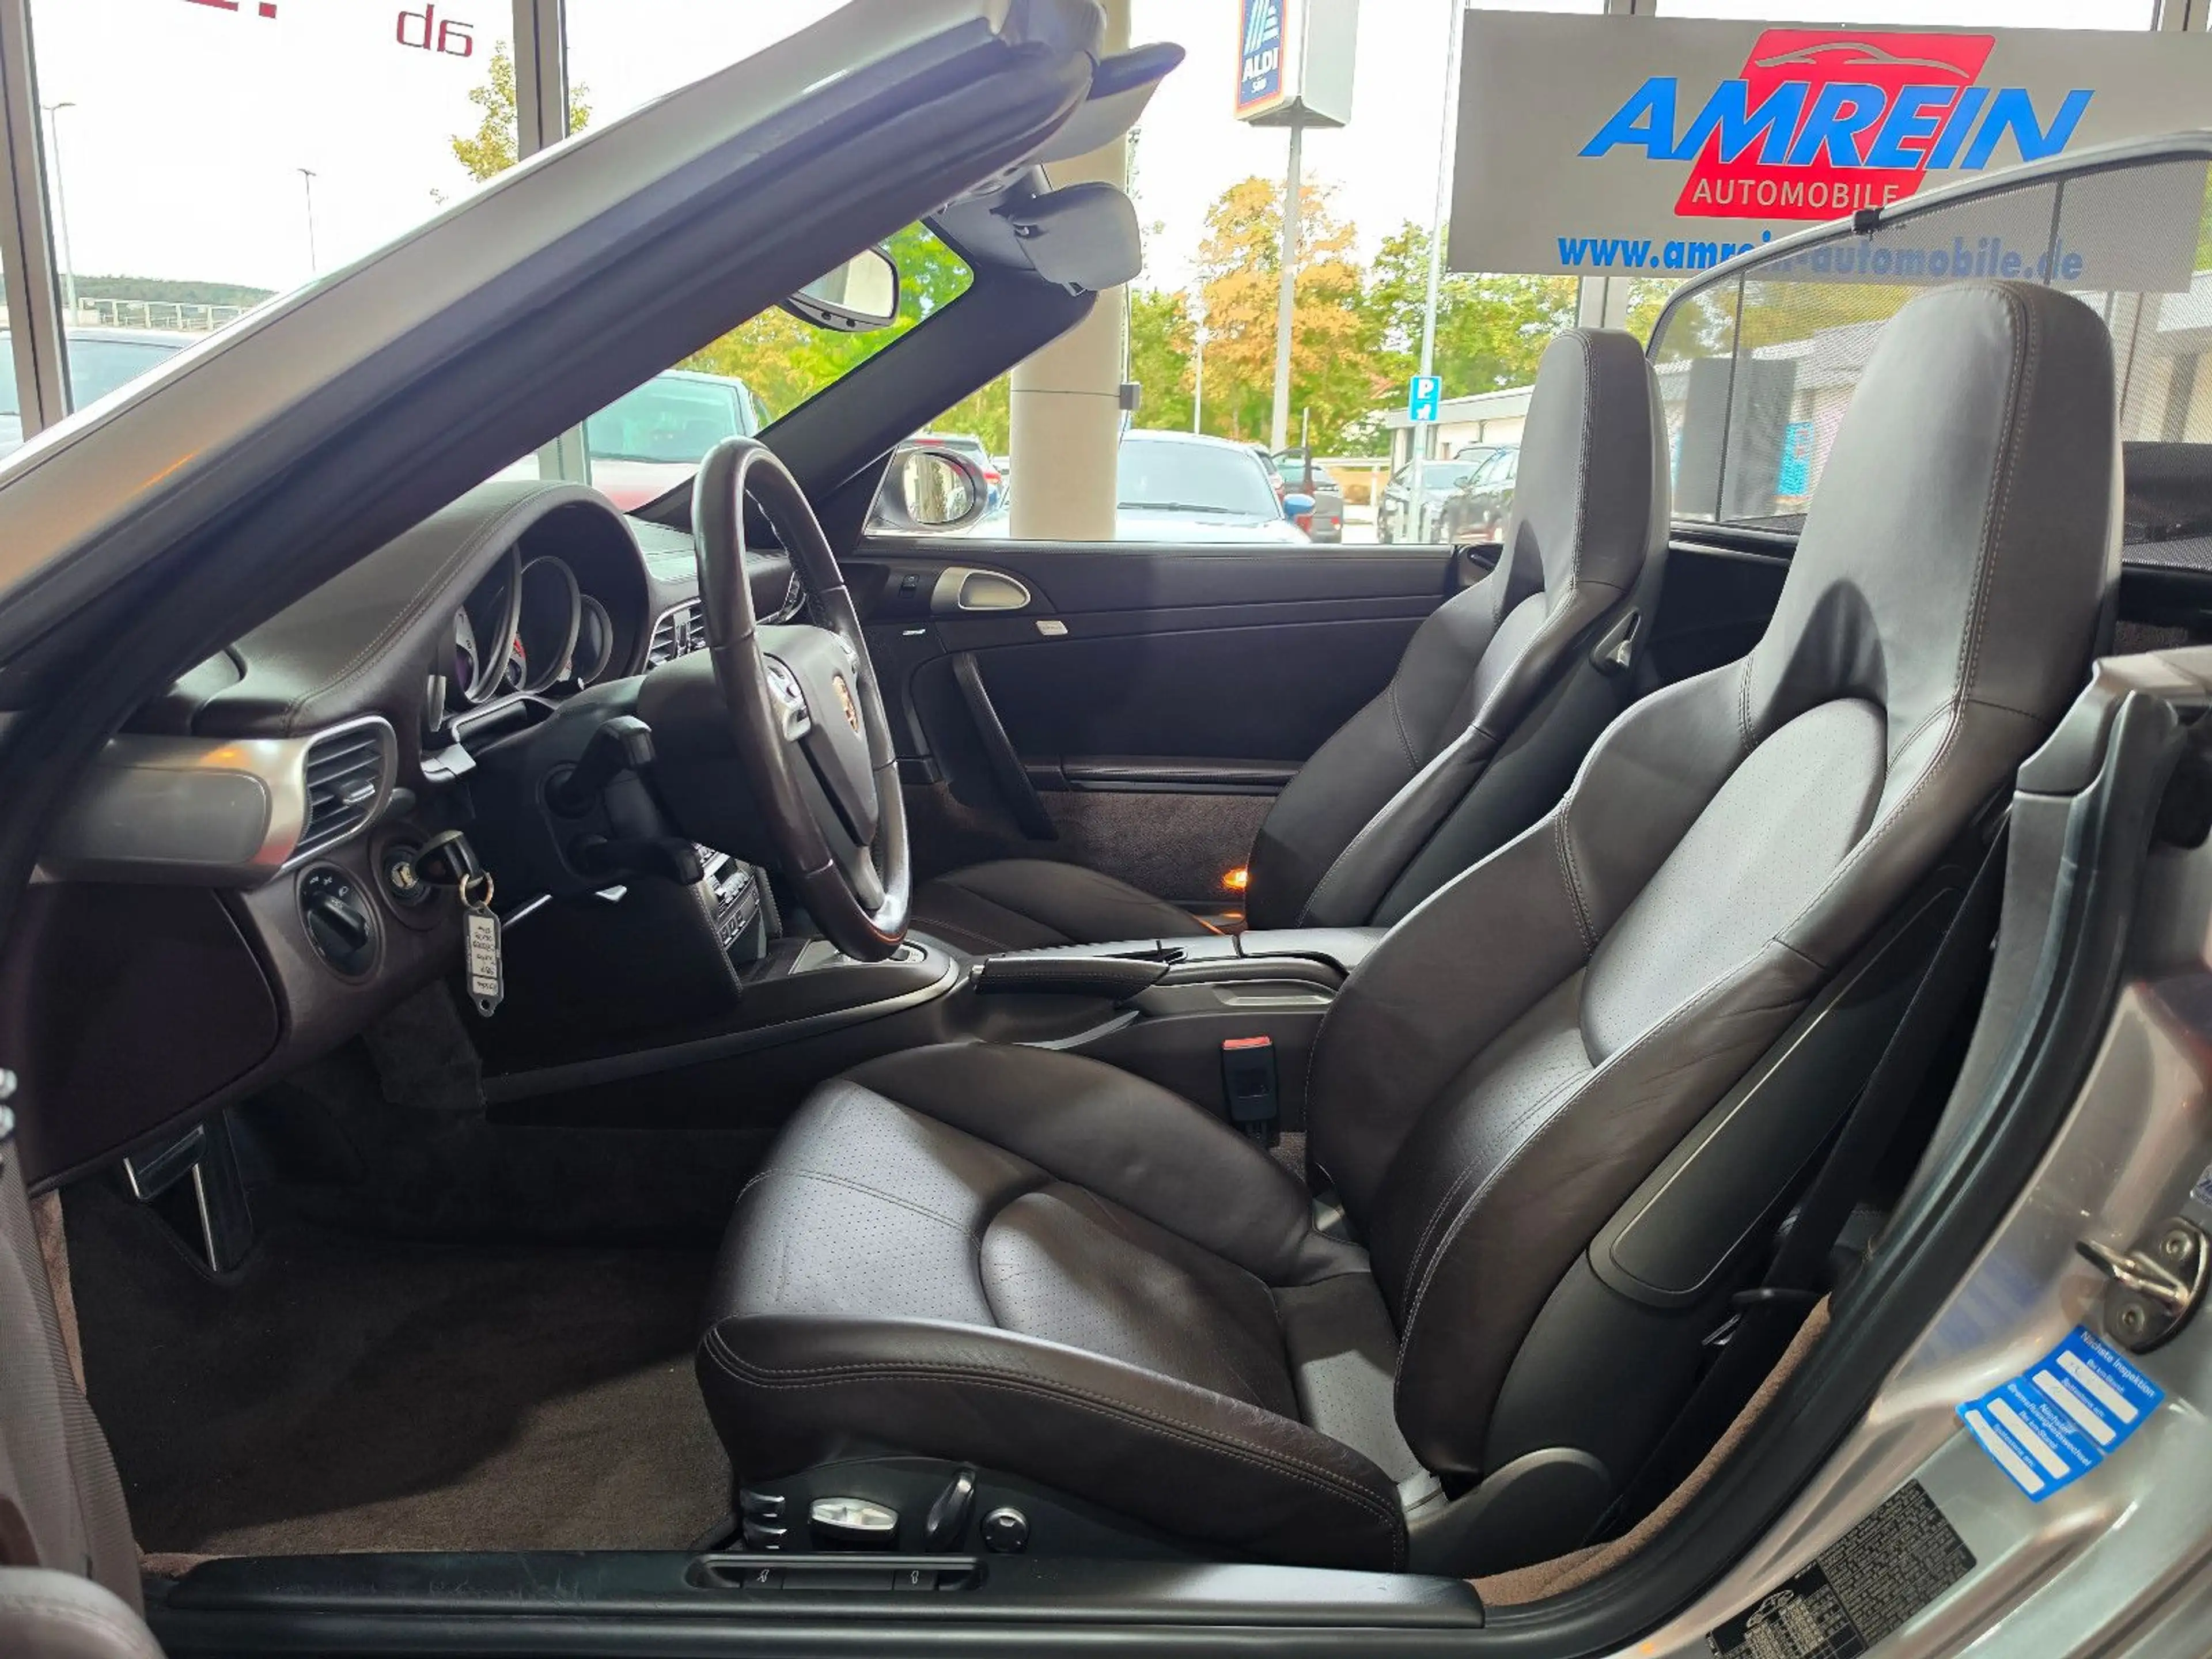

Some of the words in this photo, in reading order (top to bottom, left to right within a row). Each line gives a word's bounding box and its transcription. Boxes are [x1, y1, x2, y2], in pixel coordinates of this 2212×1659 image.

[1242, 47, 1279, 82] ALDI
[1576, 76, 2096, 169] AMREIN
[1692, 178, 1899, 209] AUTOMOBILE
[1558, 230, 2084, 281] www.amr-automobile.de
[1418, 379, 1434, 399] P
[2112, 1357, 2156, 1398] Inspektion
